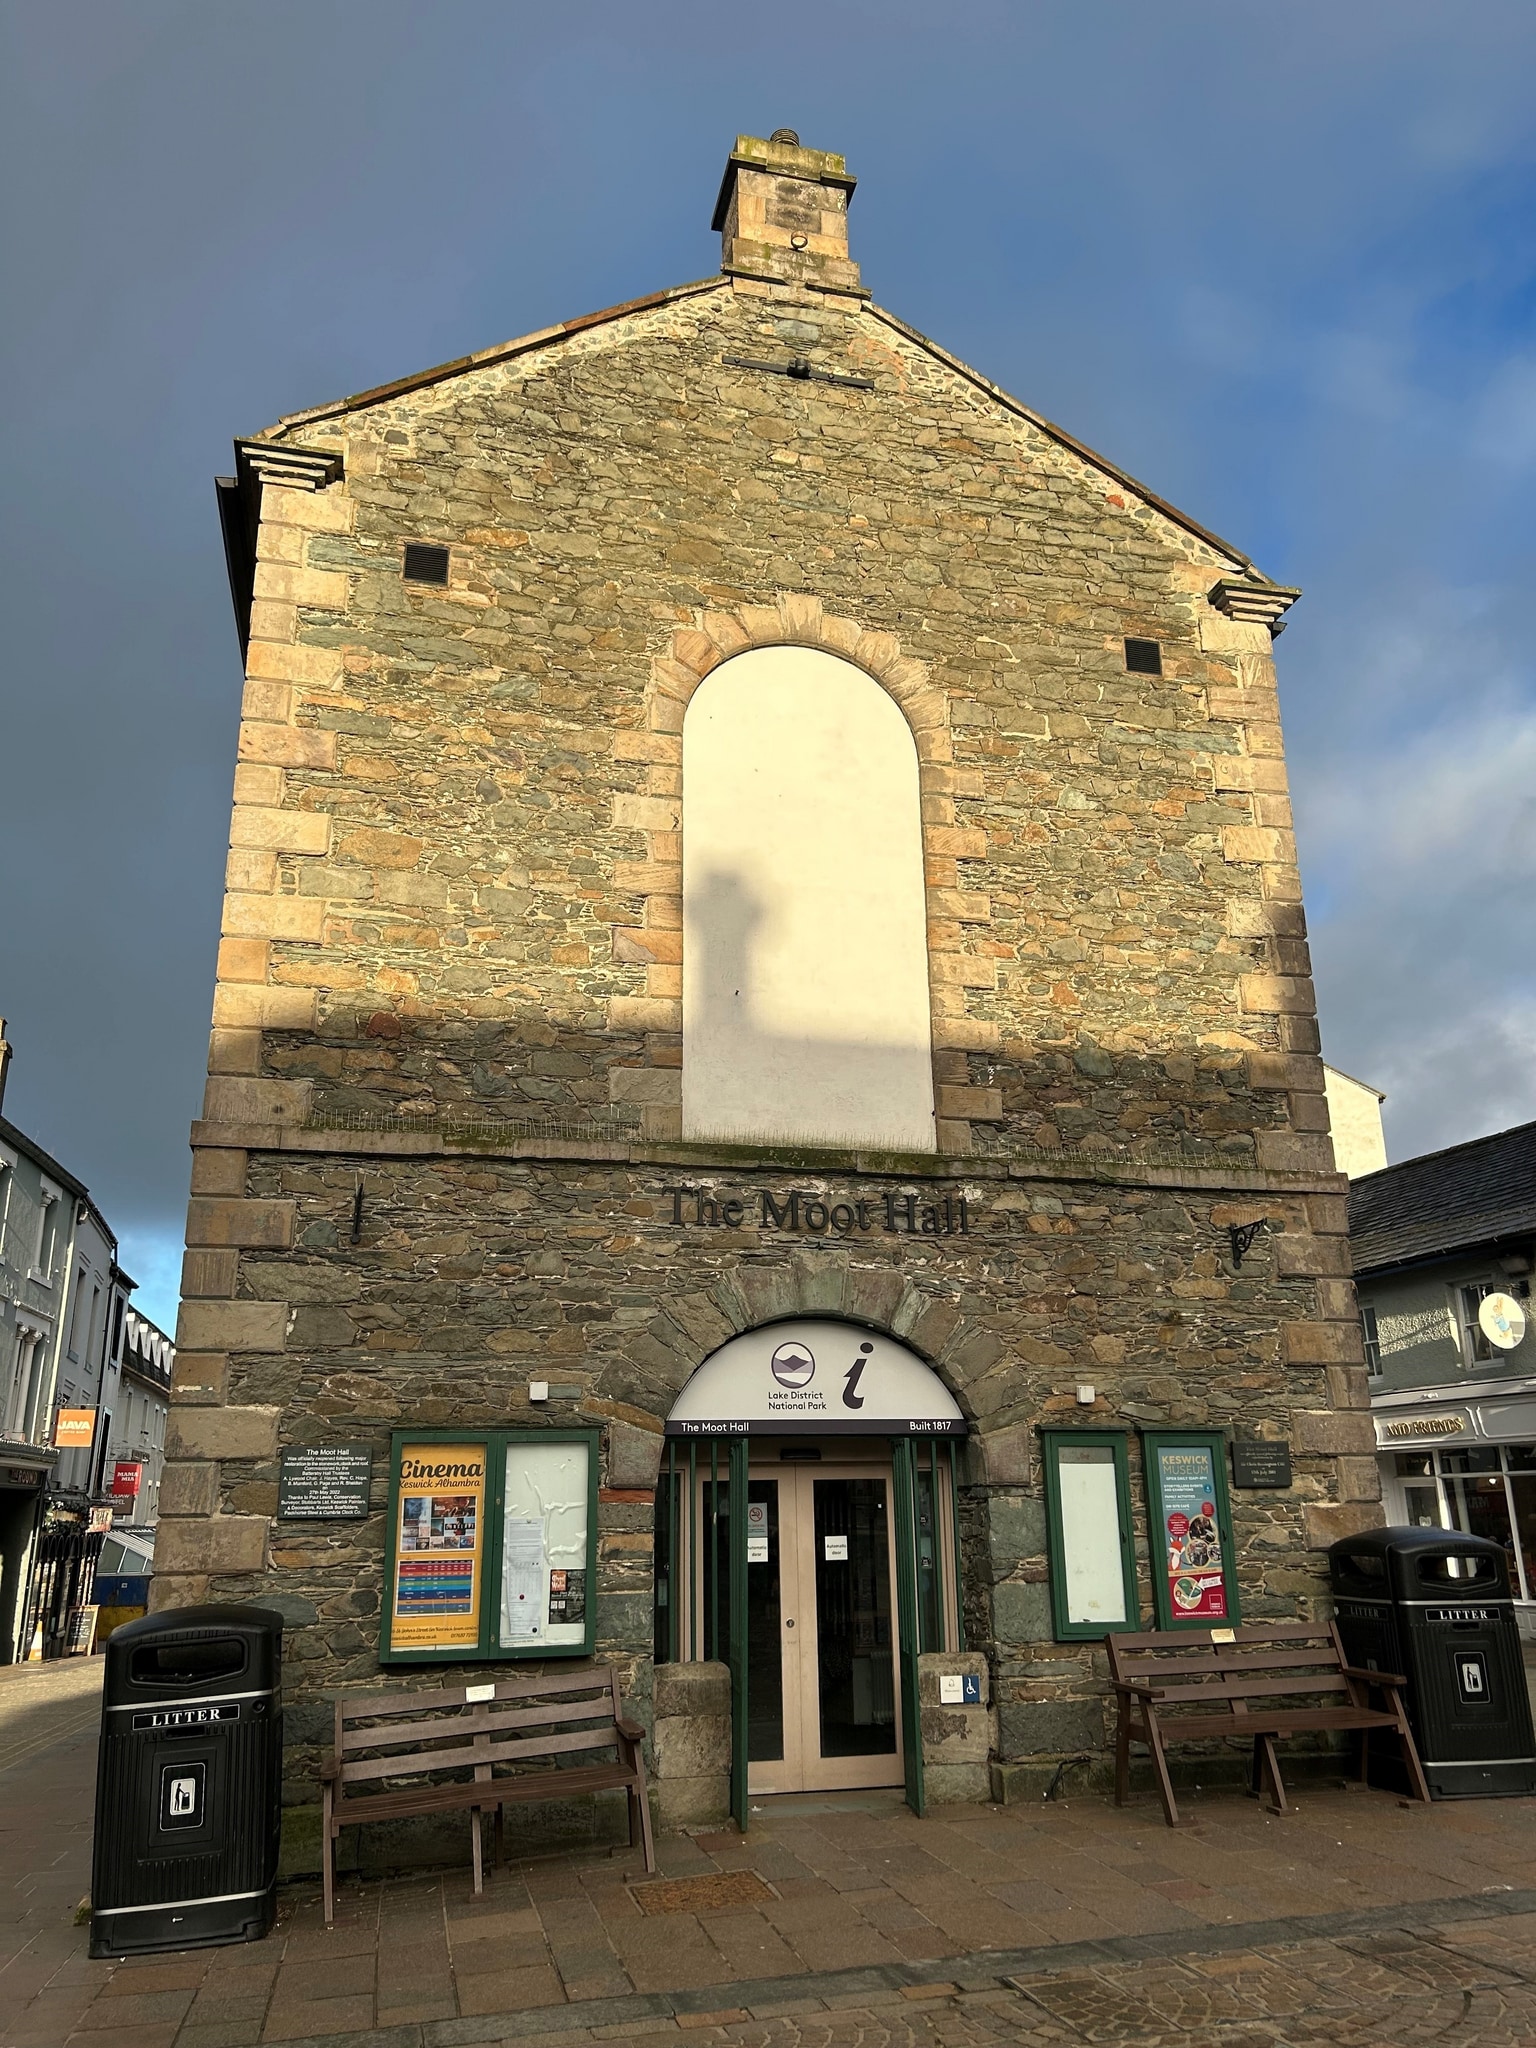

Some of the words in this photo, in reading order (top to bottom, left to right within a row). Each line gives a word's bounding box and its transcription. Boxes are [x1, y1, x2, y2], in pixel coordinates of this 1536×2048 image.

[661, 1184, 744, 1227] The
[758, 1189, 872, 1233] Moot
[881, 1192, 969, 1235] Hall
[768, 1391, 788, 1400] Lake
[790, 1391, 823, 1400] District
[768, 1402, 806, 1410] National
[808, 1402, 827, 1410] Park
[58, 1420, 90, 1430] JAVA
[681, 1422, 700, 1432] The
[702, 1422, 727, 1432] Moot
[729, 1422, 750, 1432] Hall
[910, 1421, 932, 1431] Built
[932, 1421, 952, 1431] 1817
[1386, 1422, 1411, 1436] AND
[1413, 1416, 1466, 1434] FRIENDS
[1162, 1456, 1208, 1464] KESWICK
[401, 1460, 484, 1478] Cinema
[1163, 1465, 1208, 1474] MUSEUM
[435, 1478, 480, 1488] Alhambra
[1350, 1606, 1380, 1618] LITTER
[1439, 1609, 1488, 1620] LITTER
[152, 1709, 220, 1726] LITTER
